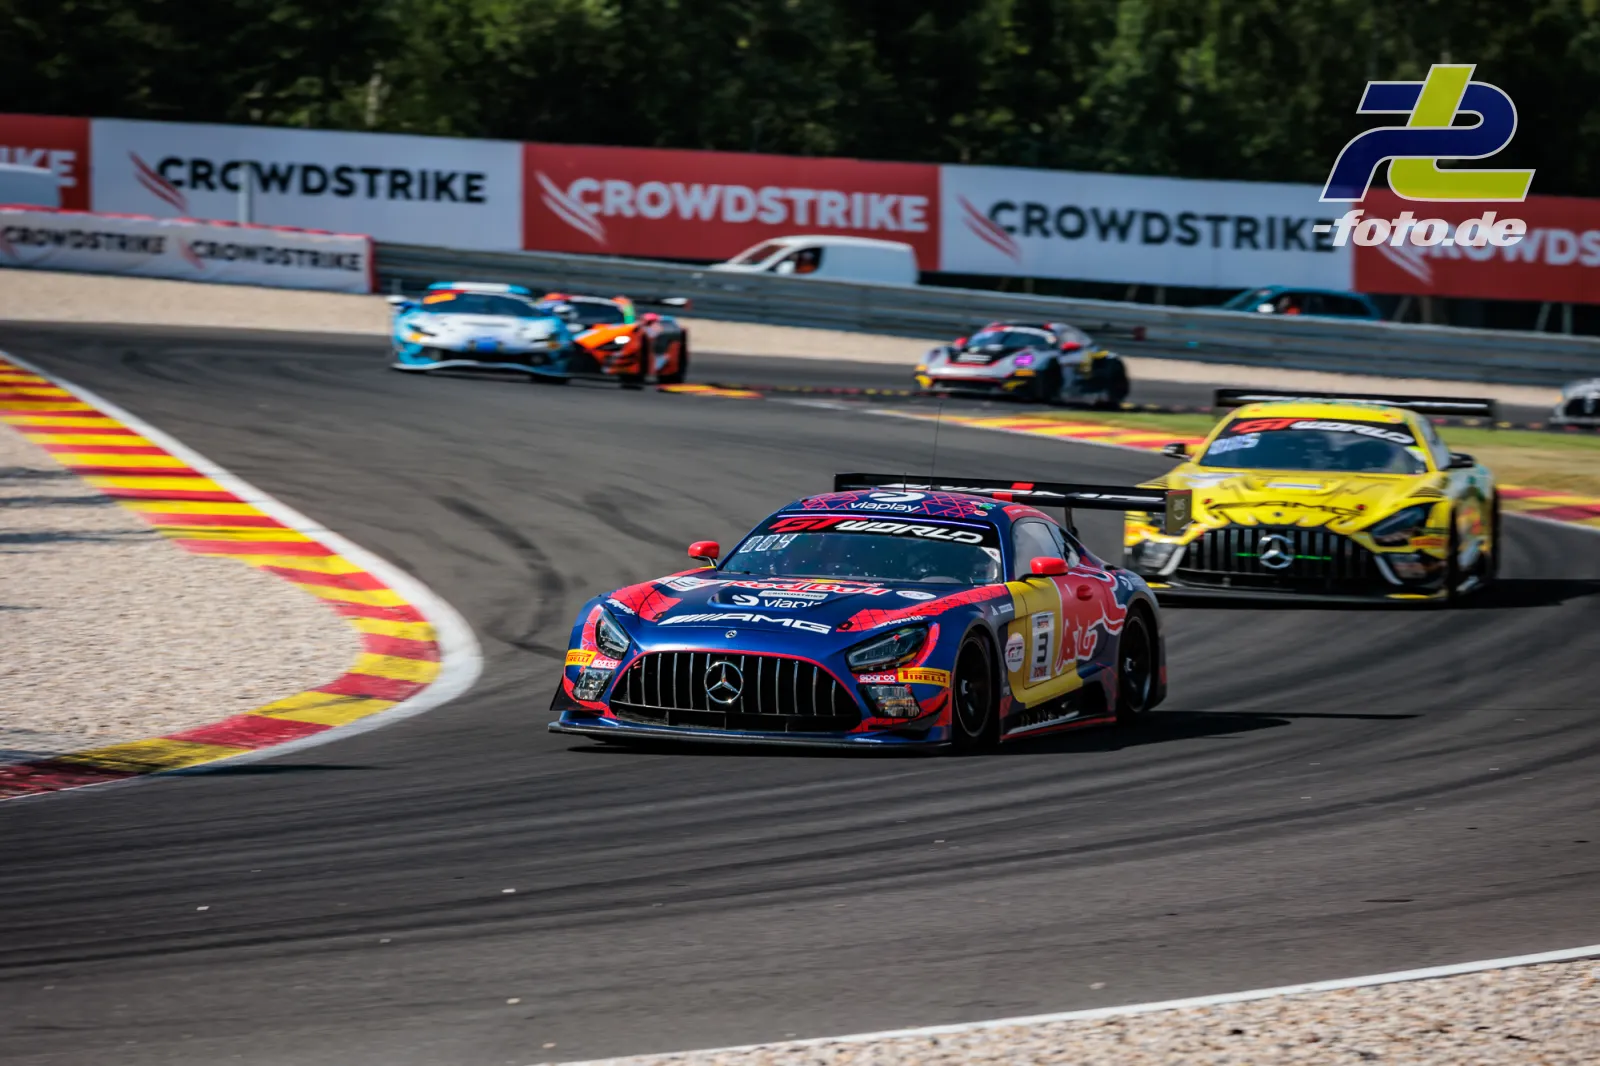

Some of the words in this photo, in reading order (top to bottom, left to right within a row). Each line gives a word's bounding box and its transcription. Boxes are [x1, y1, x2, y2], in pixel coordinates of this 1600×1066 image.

[157, 156, 487, 204] CROWDSTRIKE
[568, 178, 929, 232] CROWDSTRIKE
[4, 225, 168, 255] CROWDSTRIKE
[990, 200, 1337, 254] CROWDSTRIKE
[190, 239, 362, 272] CROWDSTRIKE
[850, 501, 920, 513] viaplay
[713, 613, 832, 635] AMG
[1036, 632, 1049, 663] 3
[859, 674, 896, 682] sparco
[902, 669, 948, 684] PIRELLI
